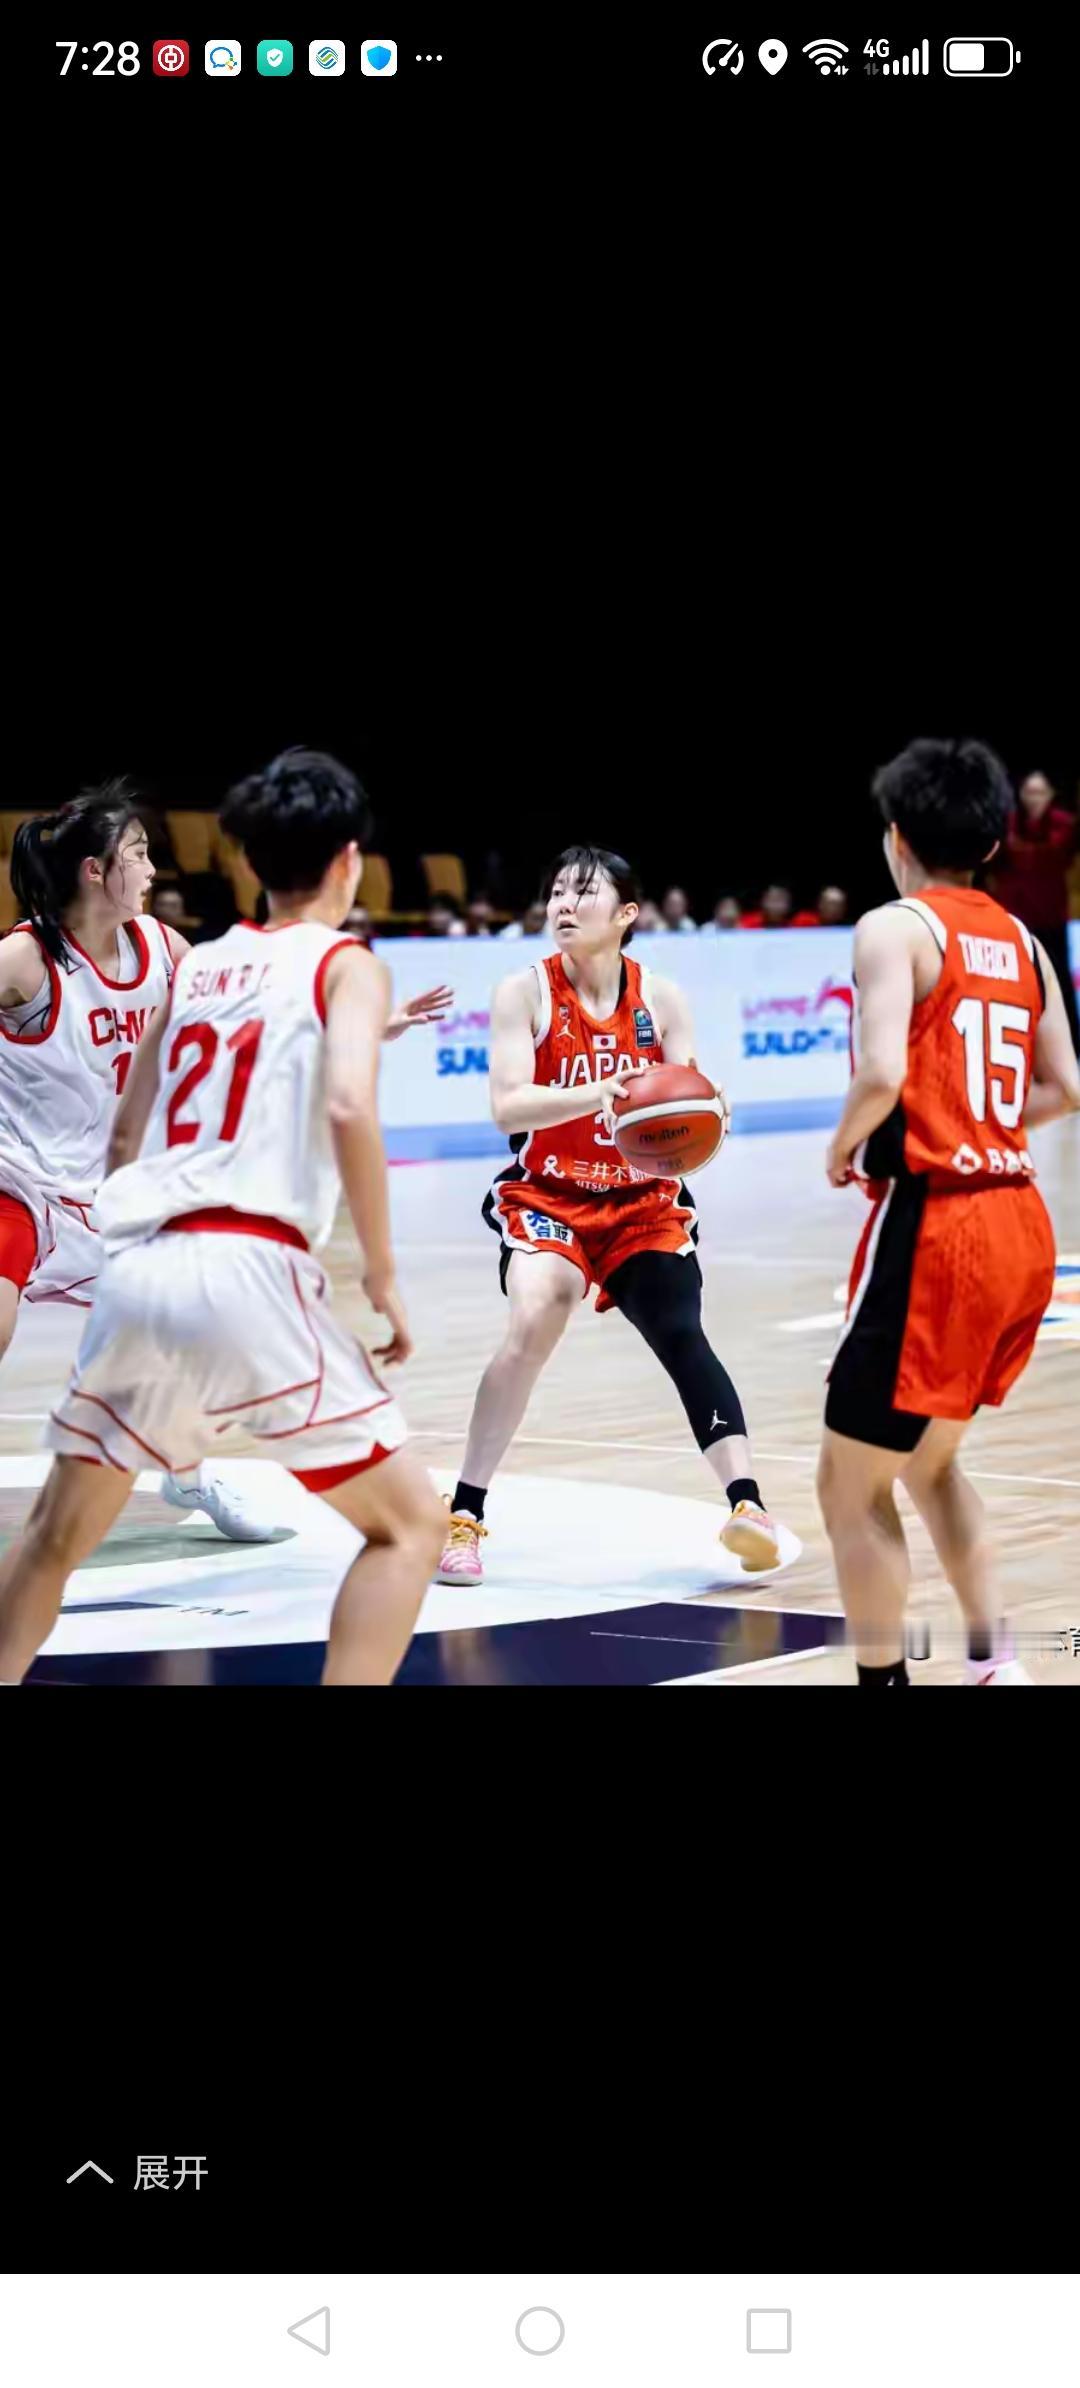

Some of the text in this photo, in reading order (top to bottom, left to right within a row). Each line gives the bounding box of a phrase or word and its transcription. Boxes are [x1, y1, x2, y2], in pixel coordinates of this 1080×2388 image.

[167, 1018, 264, 1149] 21
[593, 1110, 618, 1147] 3
[952, 998, 1030, 1129] 15
